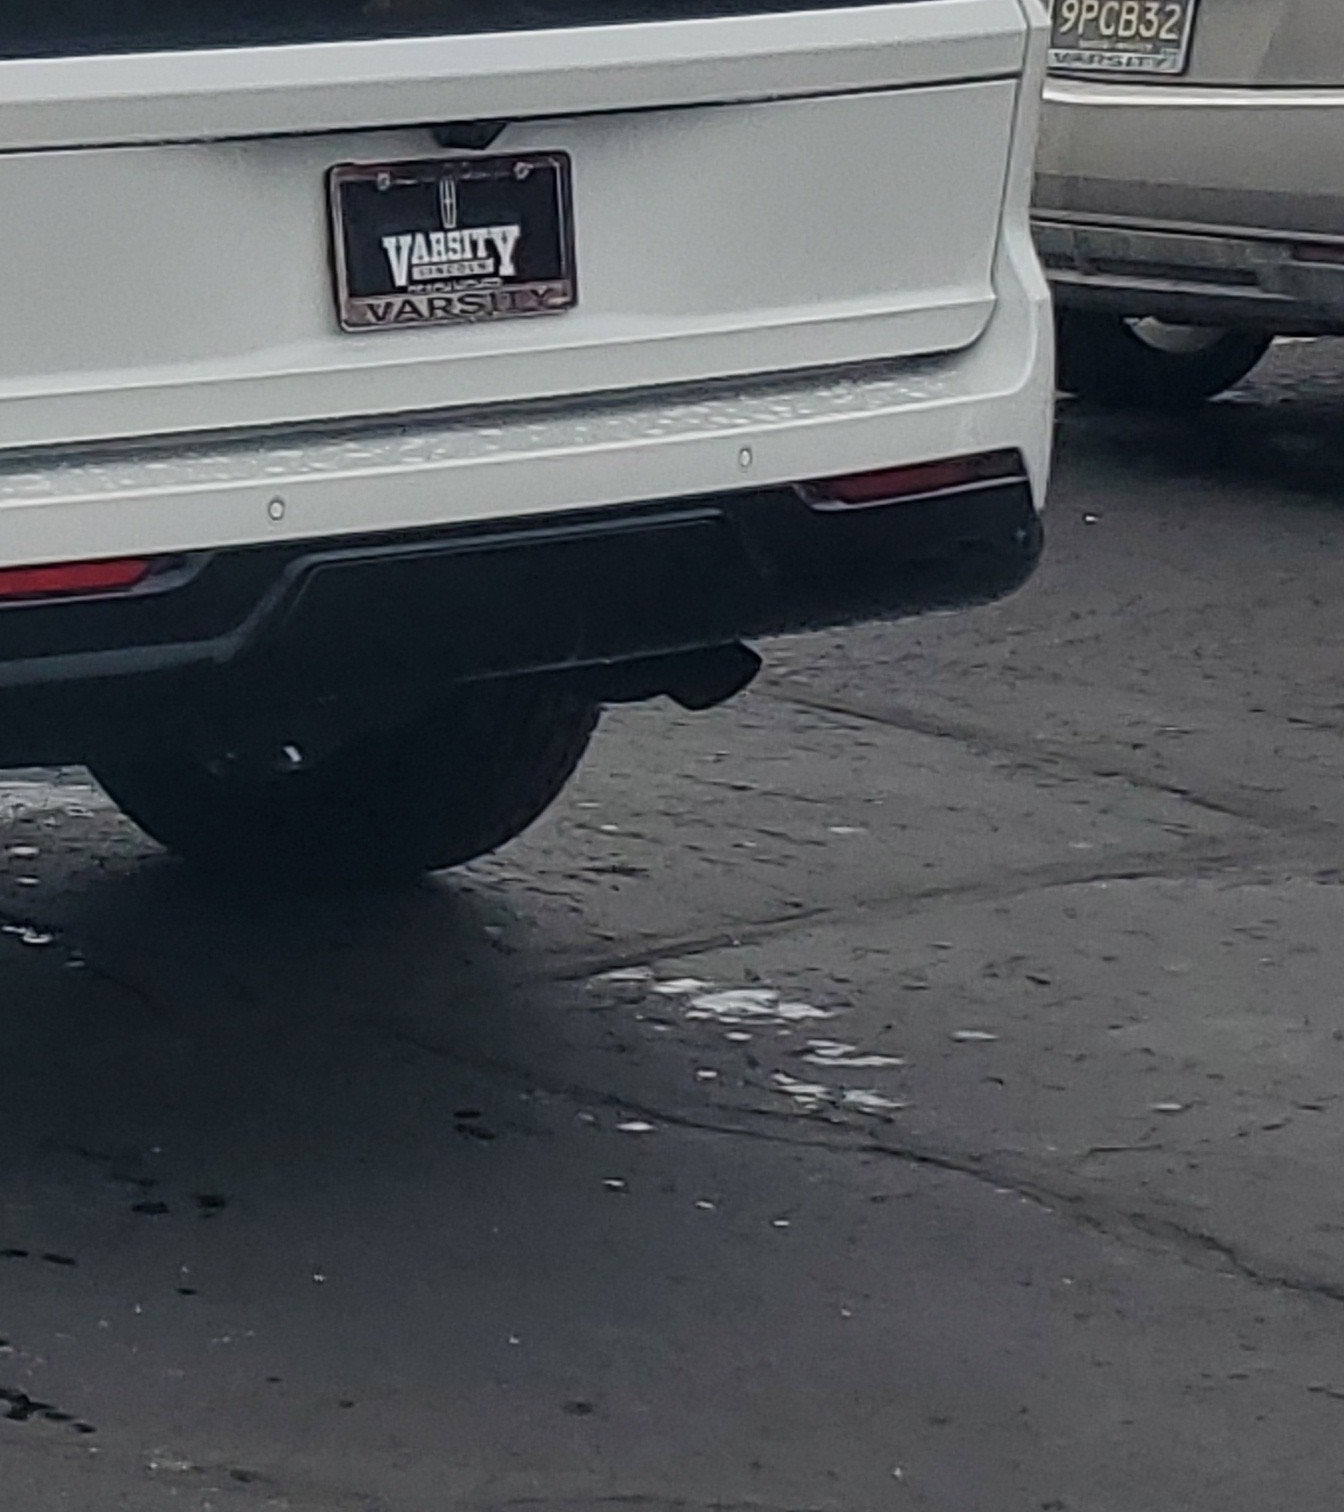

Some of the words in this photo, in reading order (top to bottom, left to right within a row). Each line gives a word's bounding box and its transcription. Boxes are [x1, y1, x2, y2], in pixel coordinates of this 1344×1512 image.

[382, 225, 520, 287] VARSITY
[418, 262, 487, 276] LINCOLN
[367, 288, 552, 323] VARSITY
